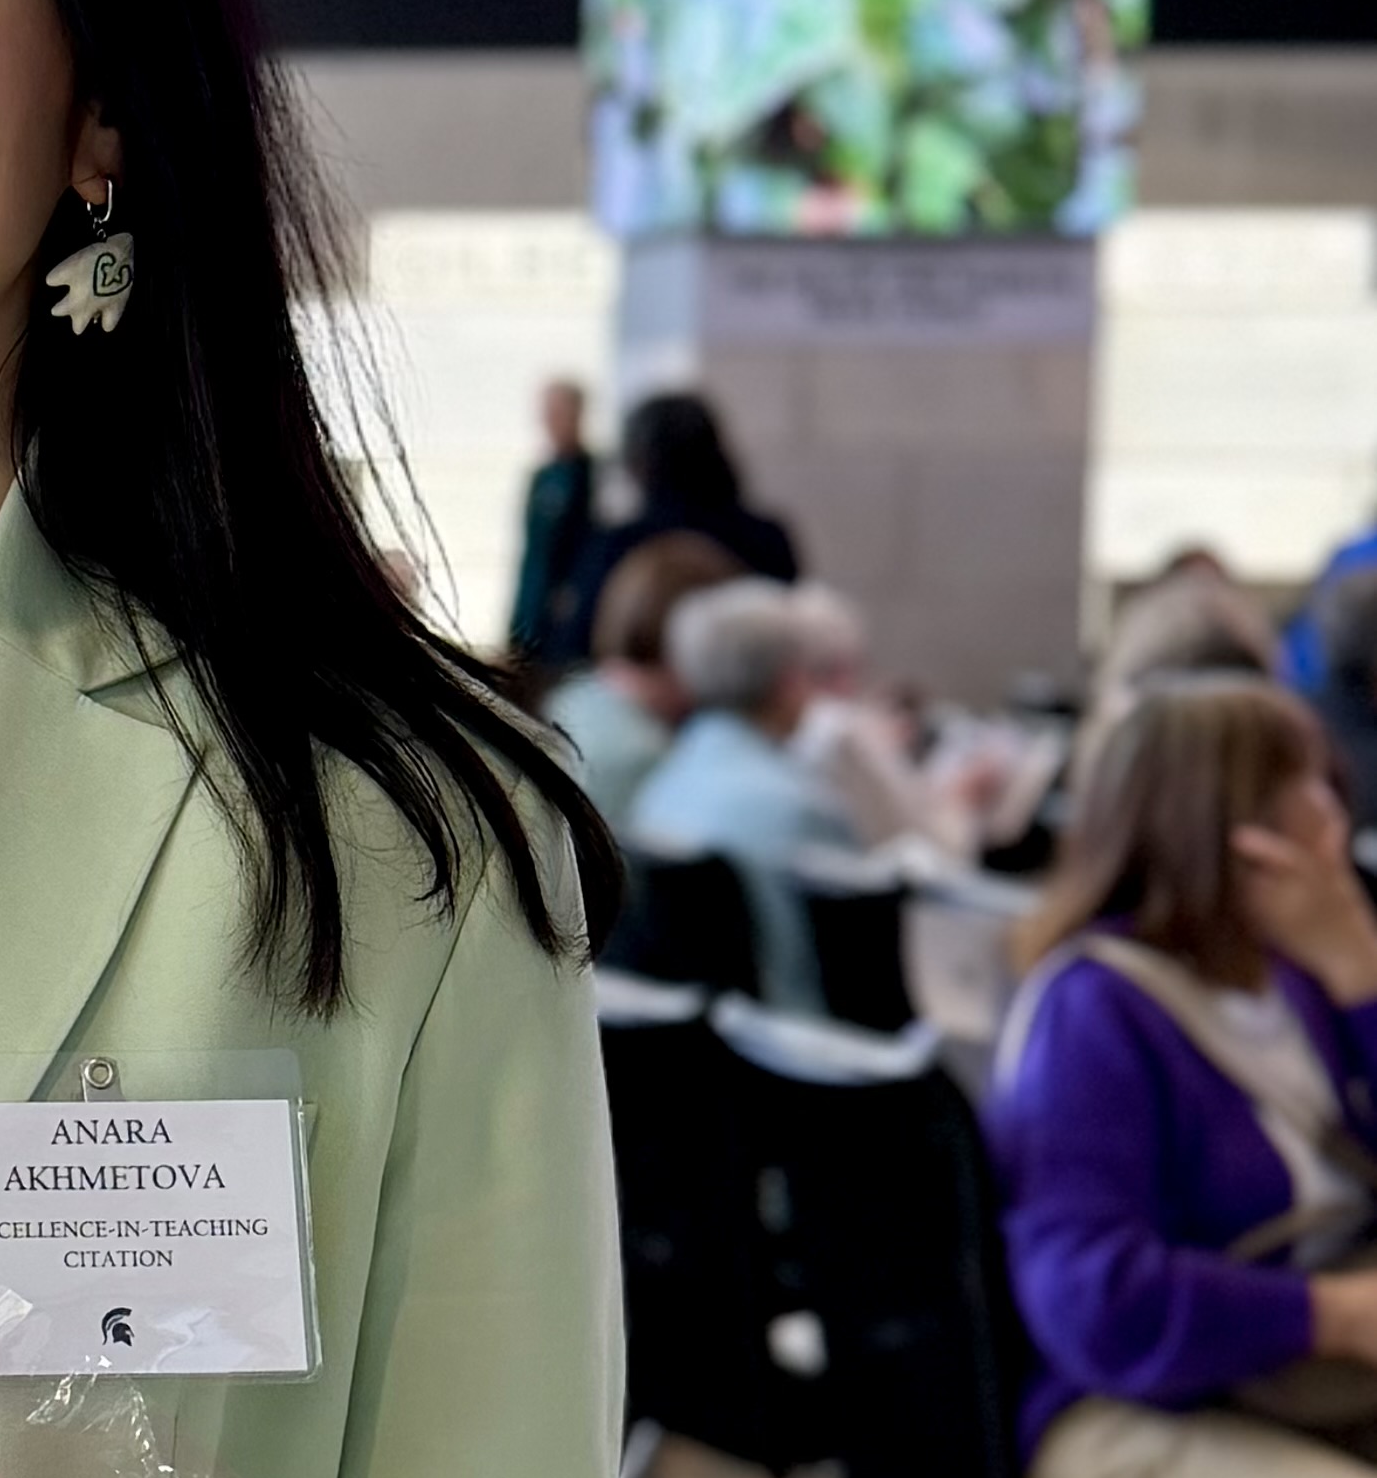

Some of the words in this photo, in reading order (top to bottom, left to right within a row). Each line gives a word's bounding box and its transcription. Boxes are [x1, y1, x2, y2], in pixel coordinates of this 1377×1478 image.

[50, 1118, 173, 1146] ANARA
[3, 1163, 227, 1192] AKHMETOVA
[62, 1250, 174, 1269] CITATION
